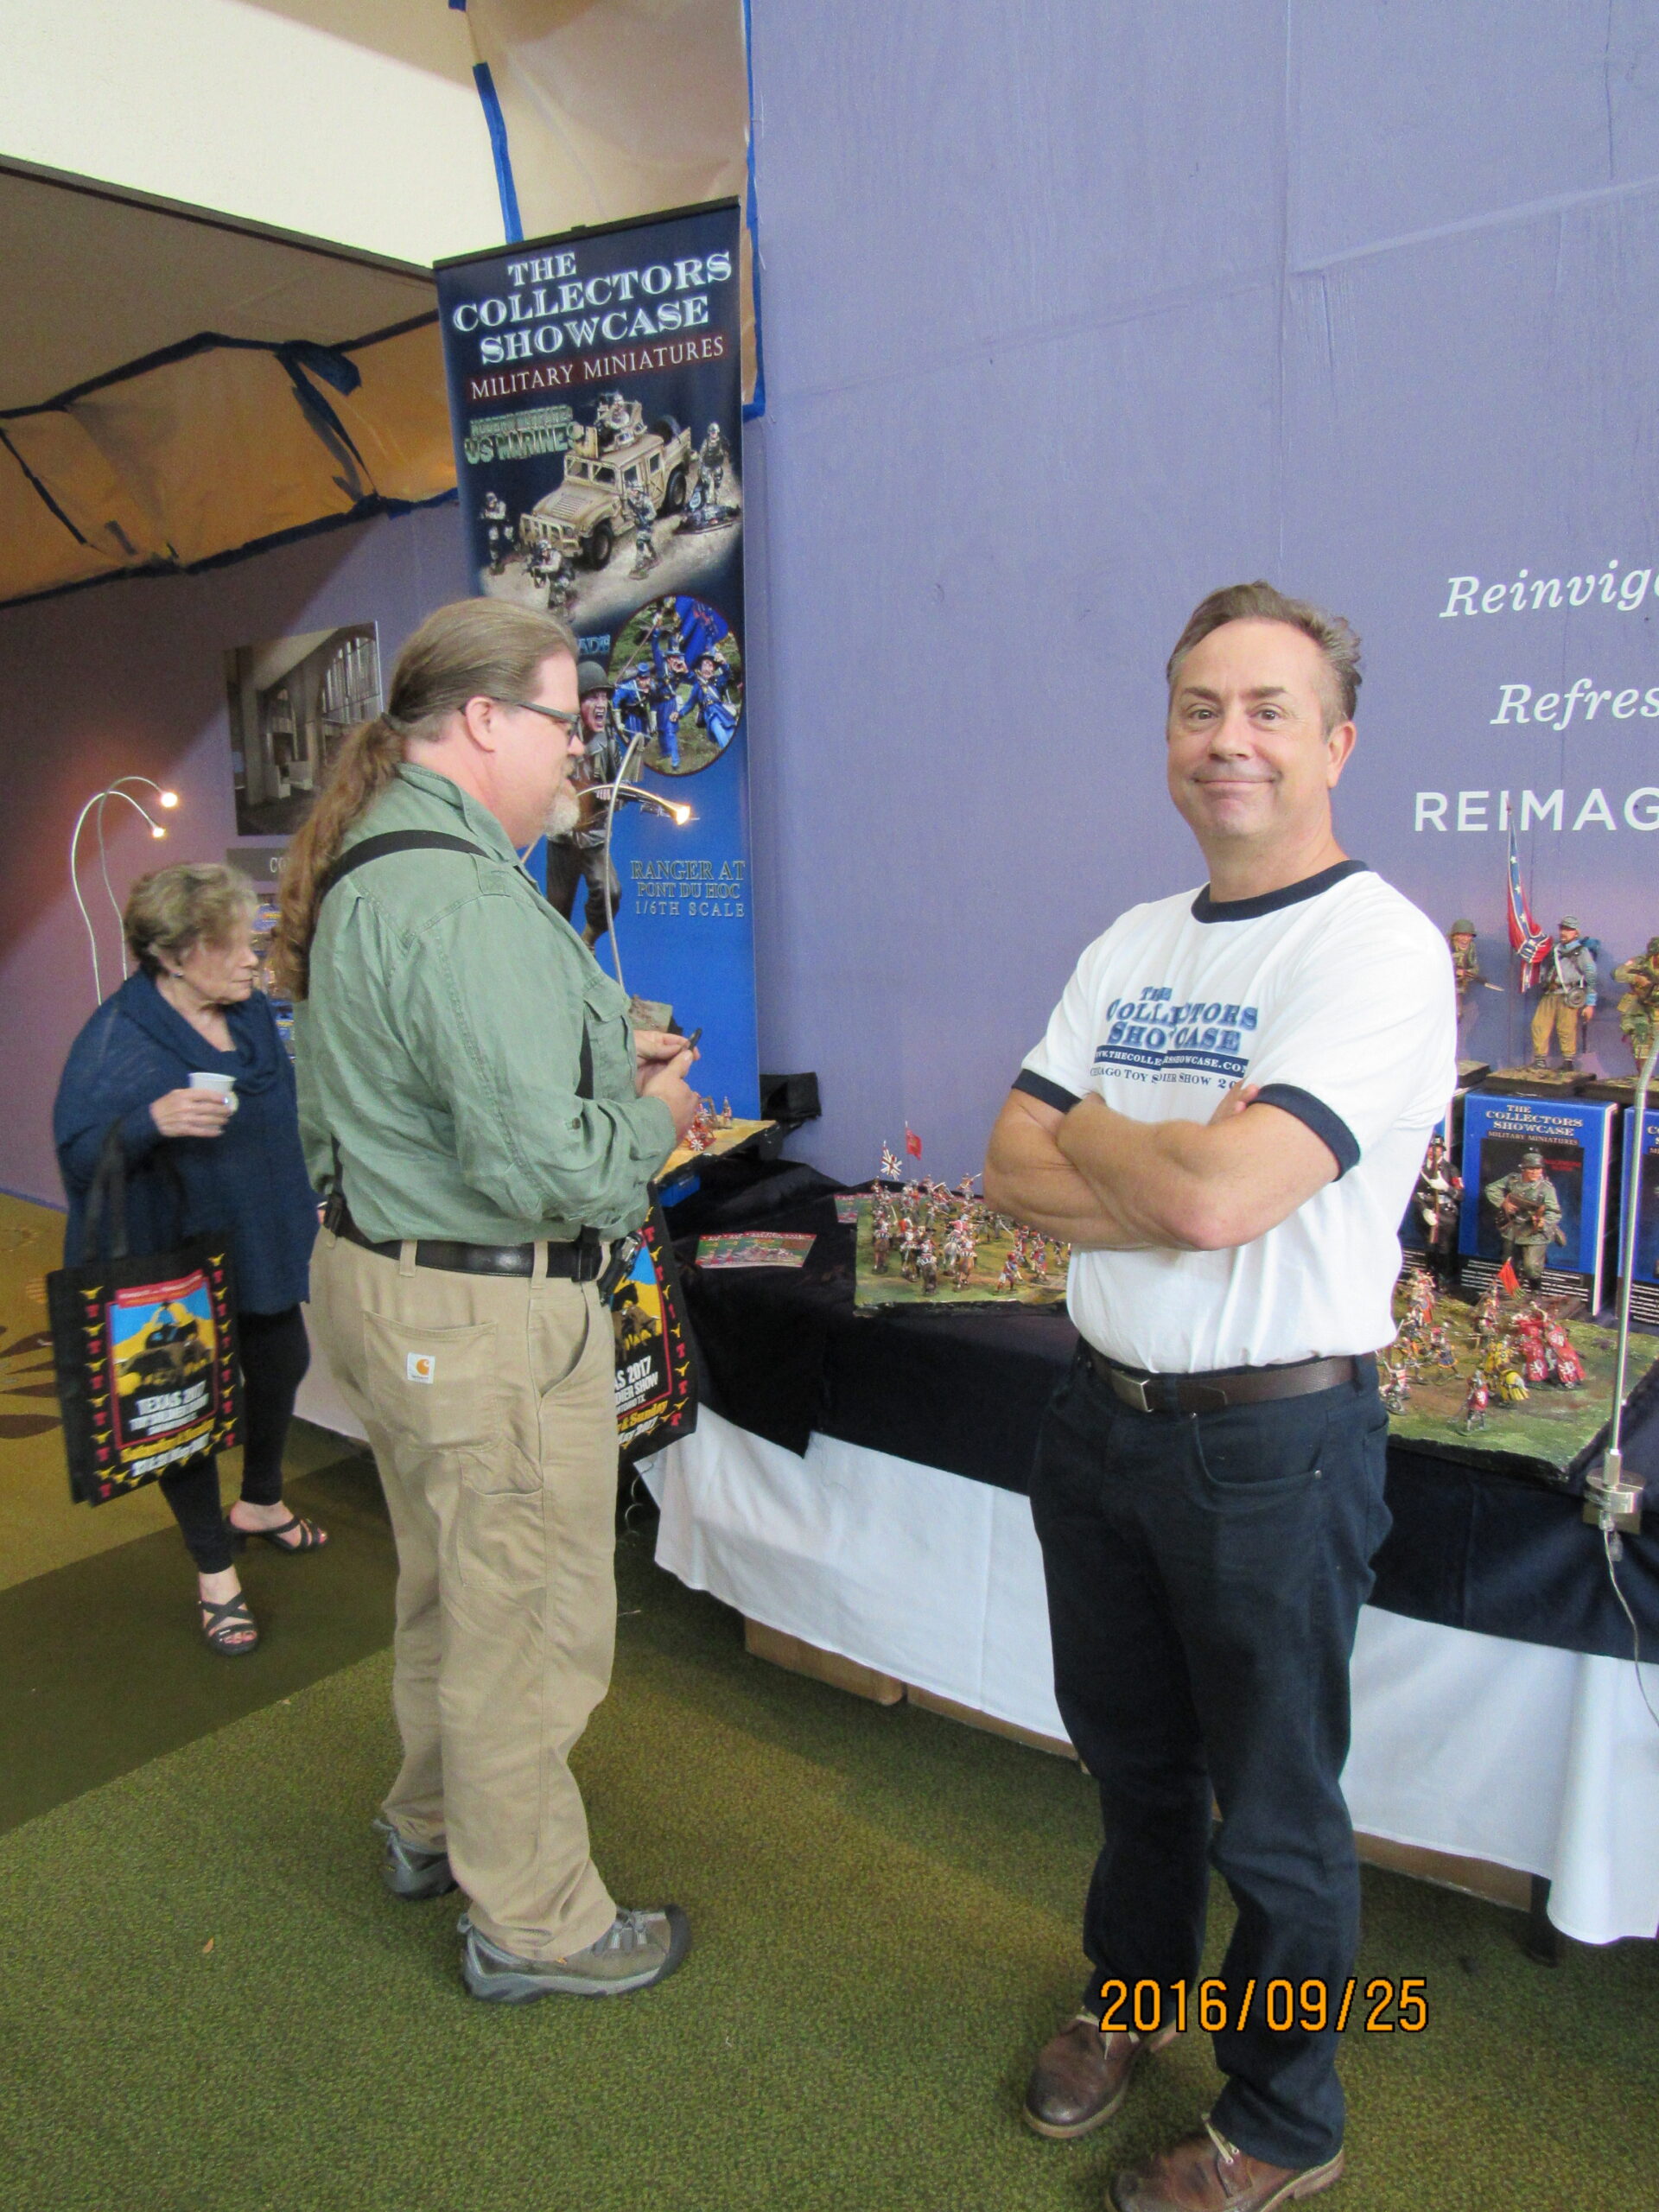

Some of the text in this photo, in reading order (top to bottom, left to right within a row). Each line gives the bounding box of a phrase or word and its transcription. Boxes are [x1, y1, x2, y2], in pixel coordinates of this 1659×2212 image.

[507, 251, 577, 287] THE
[452, 251, 732, 332] COLLECTORS
[480, 296, 709, 365] SHOWCASE
[471, 336, 723, 399] MILITARY MINIATURES
[464, 435, 494, 464] US
[1414, 787, 1659, 831] REIMAG
[630, 860, 746, 880] RANGER AT
[637, 881, 741, 899] PONT DU HOC
[635, 900, 745, 918] 1/6TH SCALE
[1106, 1021, 1242, 1057] SHOCASE
[1124, 1069, 1147, 1083] TOY
[1485, 1110, 1584, 1127] COLLECTORS
[1506, 1104, 1531, 1113] THE
[1488, 1131, 1525, 1140] MILITARY
[1493, 1121, 1574, 1136] SHOWCASE
[626, 1355, 652, 1384] 2017
[634, 1371, 658, 1395] SHOW
